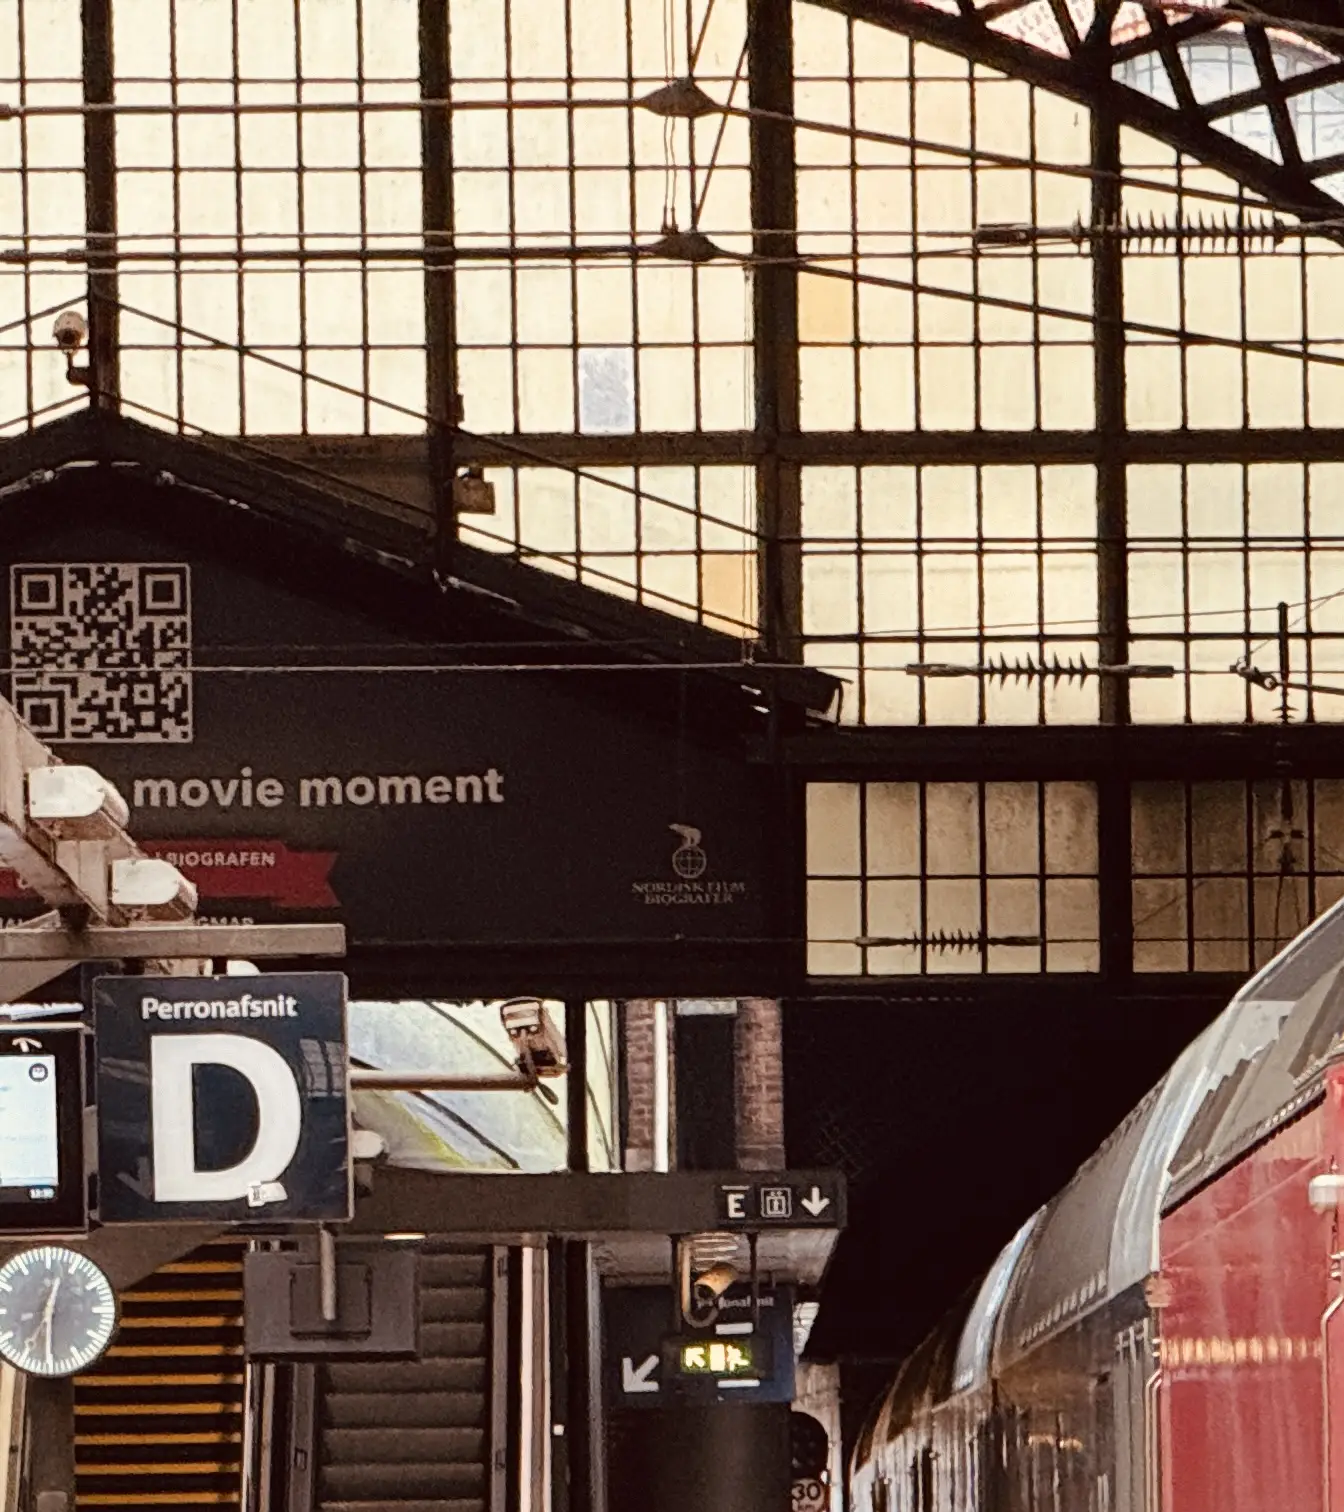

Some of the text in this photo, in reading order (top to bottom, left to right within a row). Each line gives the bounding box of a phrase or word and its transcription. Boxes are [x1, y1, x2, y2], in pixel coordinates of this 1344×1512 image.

[133, 766, 504, 808] movie moment
[141, 994, 298, 1020] Perronafsnit
[150, 1034, 303, 1203] D
[727, 1193, 746, 1218] E
[792, 1483, 820, 1501] 30
